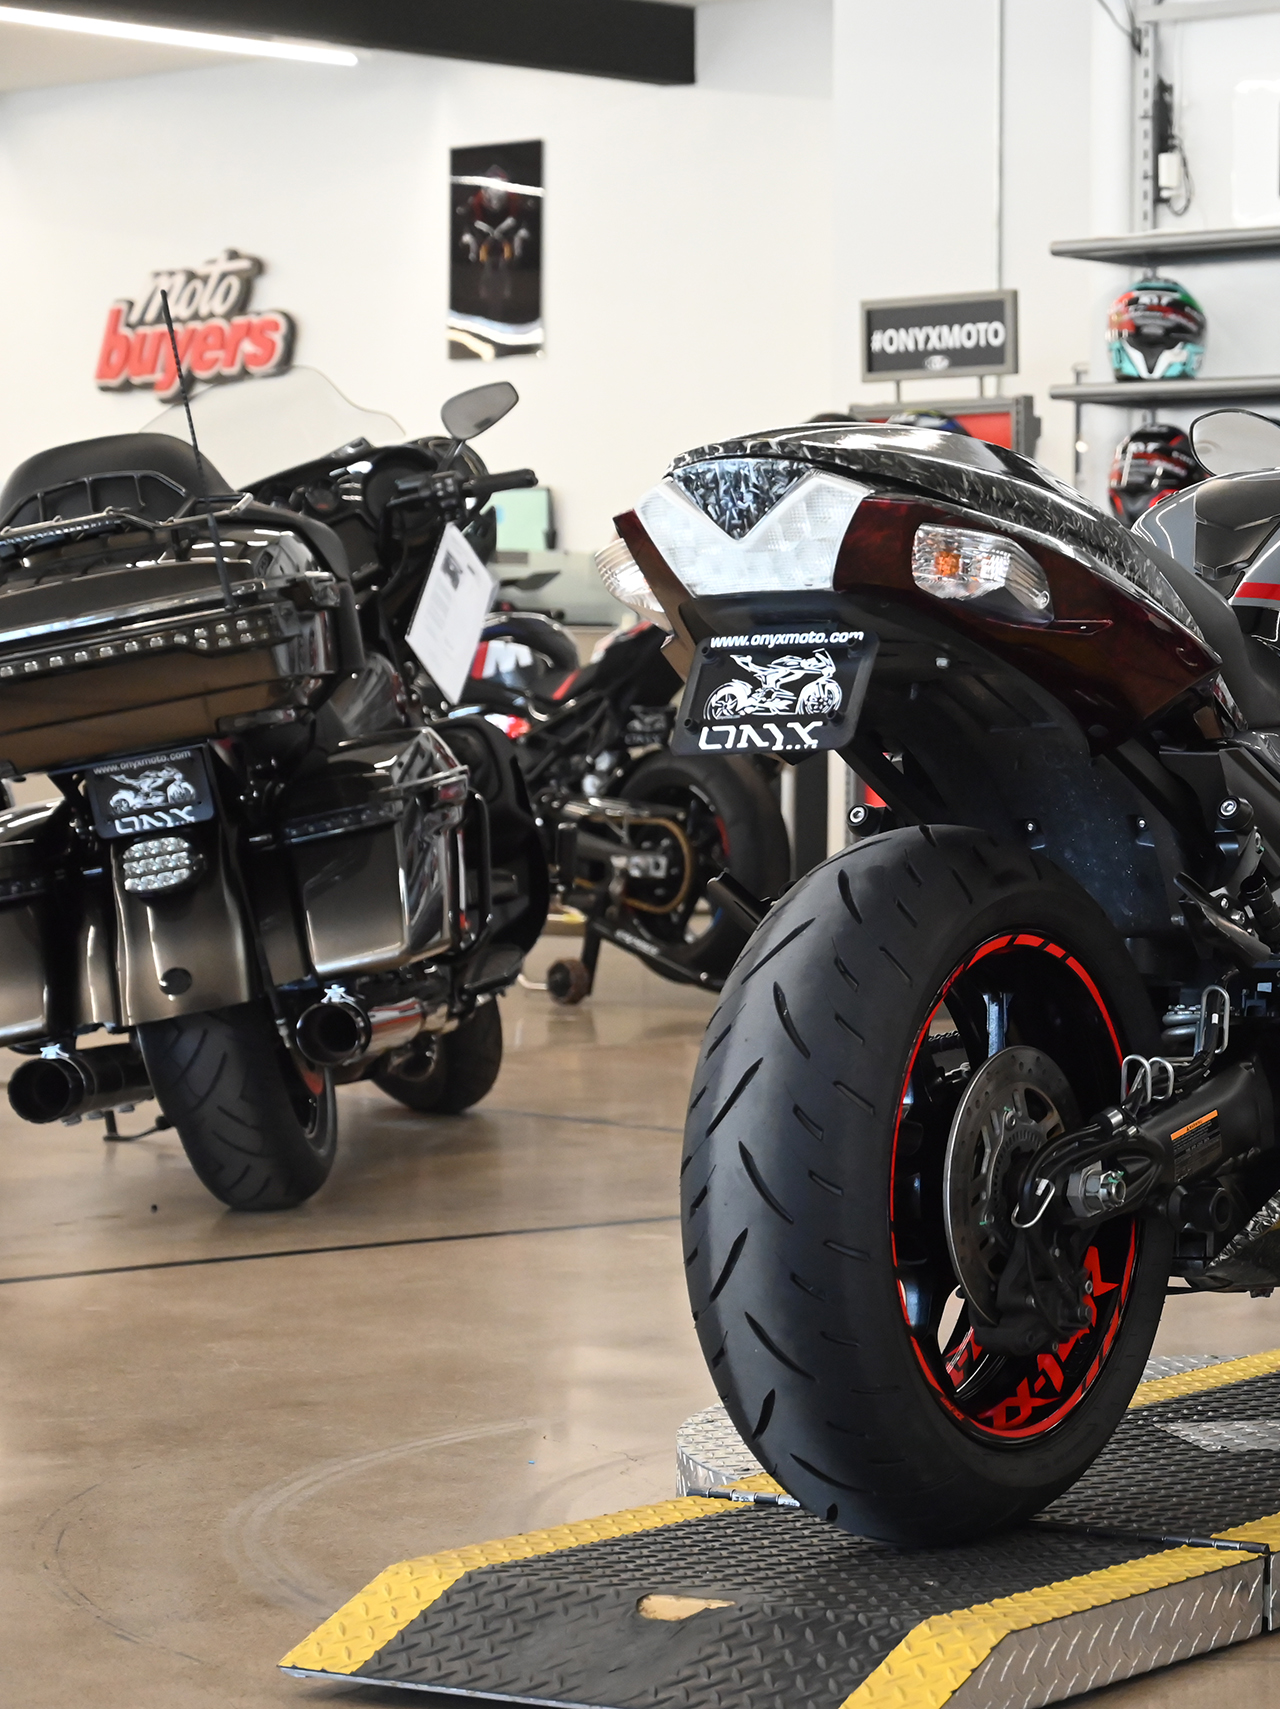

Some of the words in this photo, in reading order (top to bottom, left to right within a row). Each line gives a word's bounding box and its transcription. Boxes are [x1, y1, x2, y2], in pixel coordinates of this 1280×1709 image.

[95, 304, 281, 392] buyers
[870, 320, 1006, 354] #ONYXMOTO
[711, 630, 864, 648] www.onyxmoto.com
[698, 720, 823, 751] ONYX
[93, 750, 191, 774] www.onyxmoto.com
[114, 805, 196, 834] ONYX
